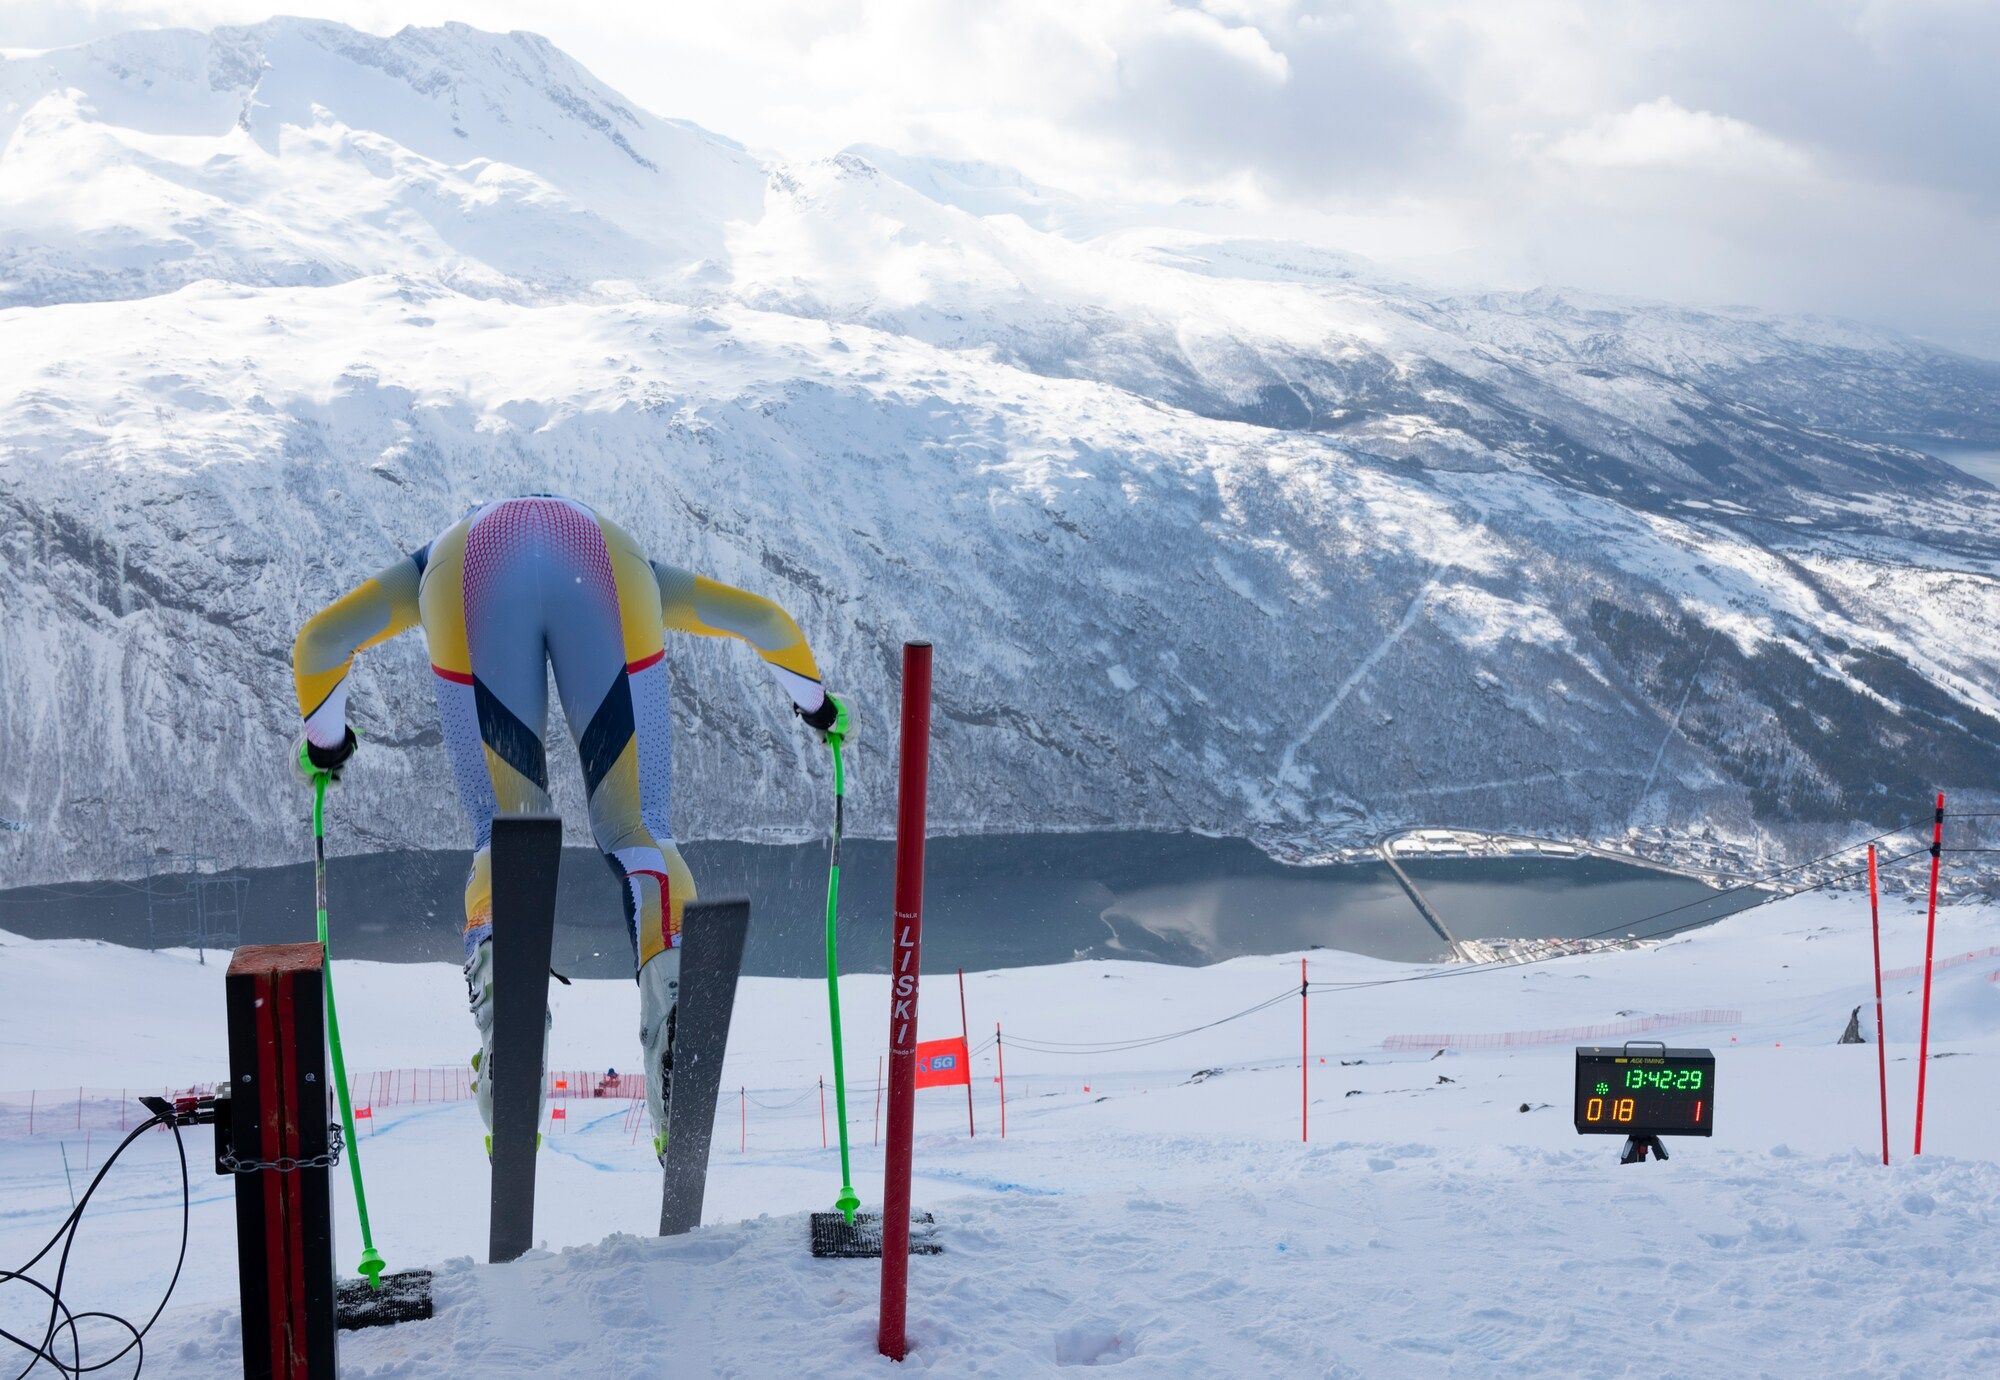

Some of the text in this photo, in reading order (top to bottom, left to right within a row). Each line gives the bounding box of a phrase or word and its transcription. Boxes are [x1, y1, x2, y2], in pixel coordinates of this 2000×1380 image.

[895, 926, 914, 1044] LISKI
[933, 1057, 953, 1069] 5G
[1626, 1070, 1702, 1089] 13:42:29
[1587, 1099, 1702, 1121] 018 1
